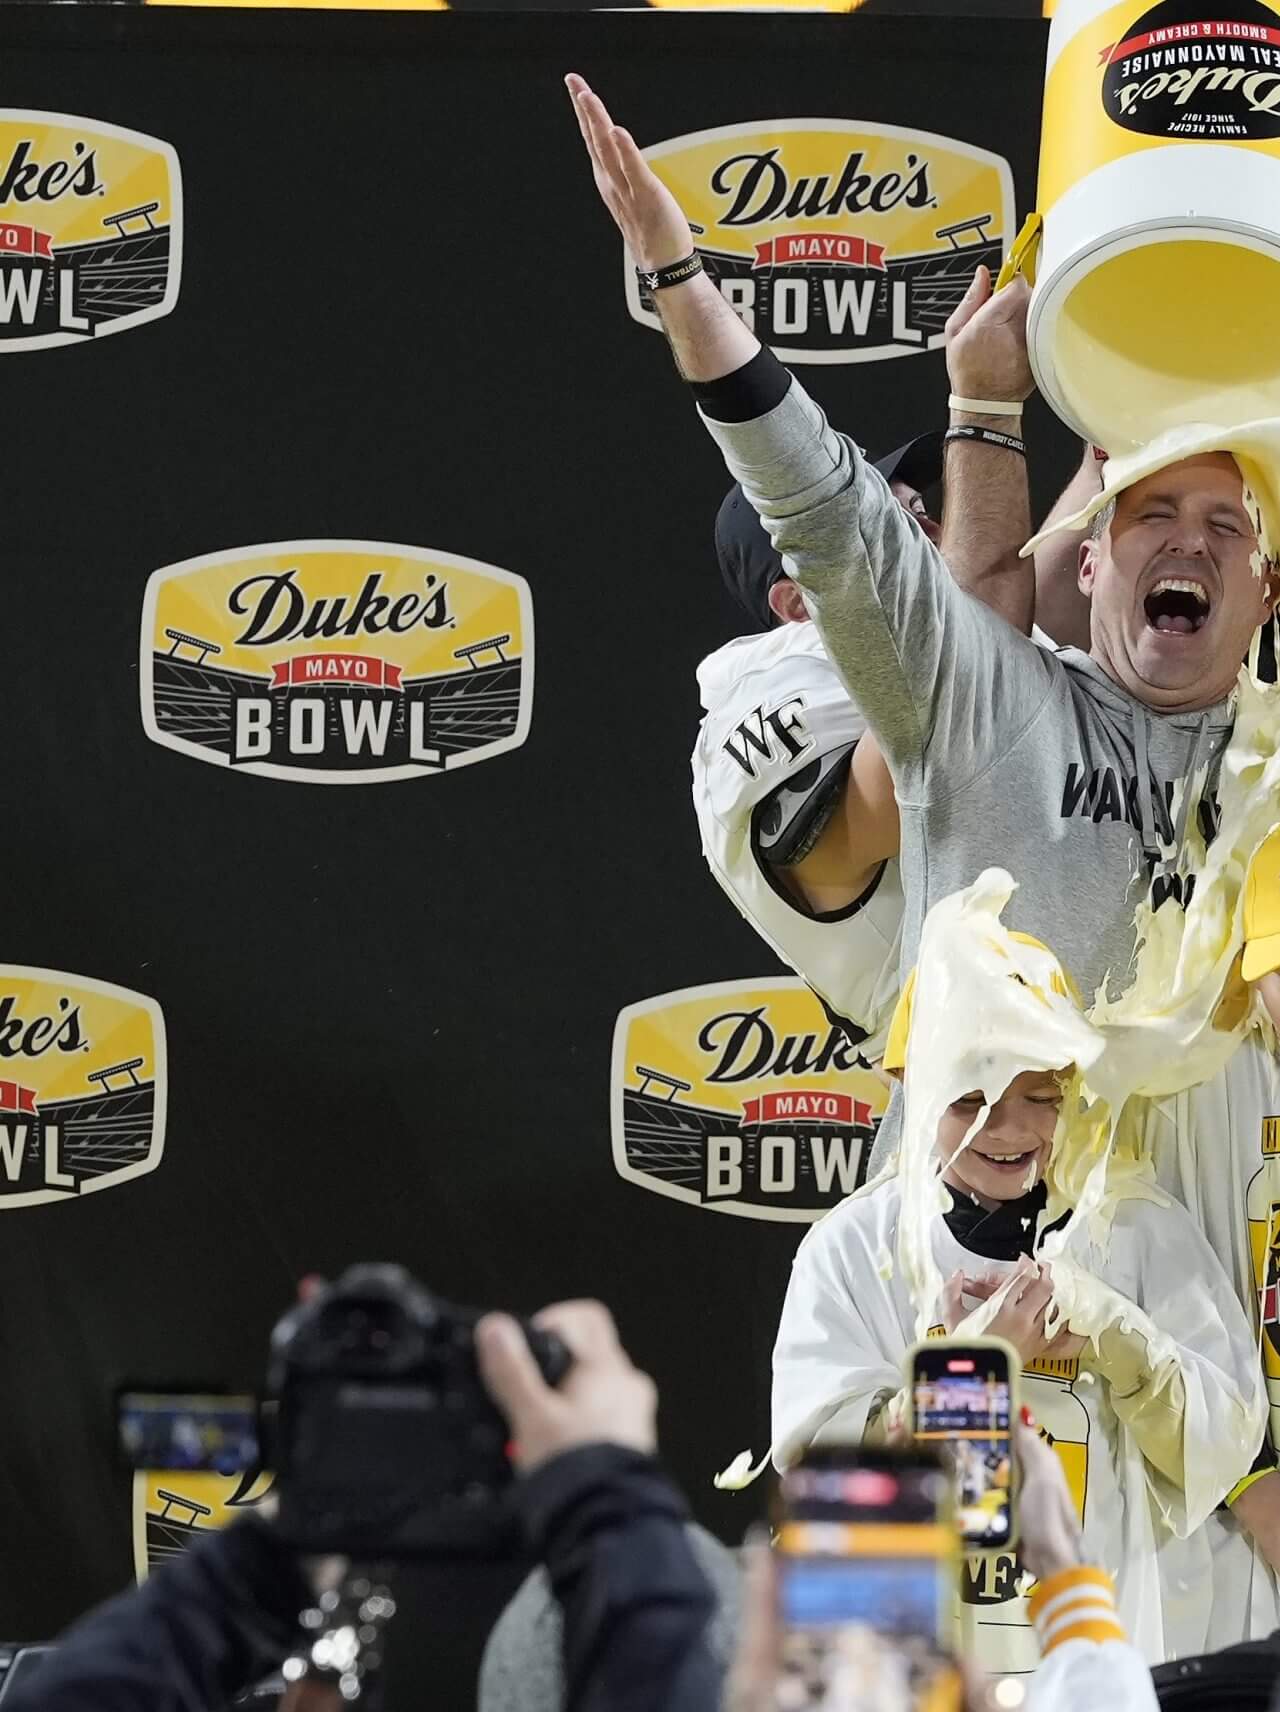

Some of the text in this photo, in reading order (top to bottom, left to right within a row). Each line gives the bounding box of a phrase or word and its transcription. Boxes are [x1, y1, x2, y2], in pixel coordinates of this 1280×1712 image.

[1121, 44, 1246, 78] MAYONNAISE
[1148, 23, 1268, 45] SMOOTH & CREAMY
[1167, 121, 1248, 134] FAMILY RECIPE
[1204, 113, 1235, 122] SINCE
[0, 141, 105, 202] ke's
[711, 148, 938, 226] Duke's
[788, 239, 851, 258] MAYO
[0, 268, 89, 331] WL
[720, 278, 922, 342] BOWL
[228, 569, 456, 645] Duke's
[306, 658, 368, 679] MAYO
[235, 698, 440, 761] BOWL
[722, 697, 809, 777] WF
[0, 997, 90, 1057] ke's
[699, 1007, 858, 1083] Duk
[775, 1096, 838, 1116] MAYO
[707, 1135, 863, 1197] BOW
